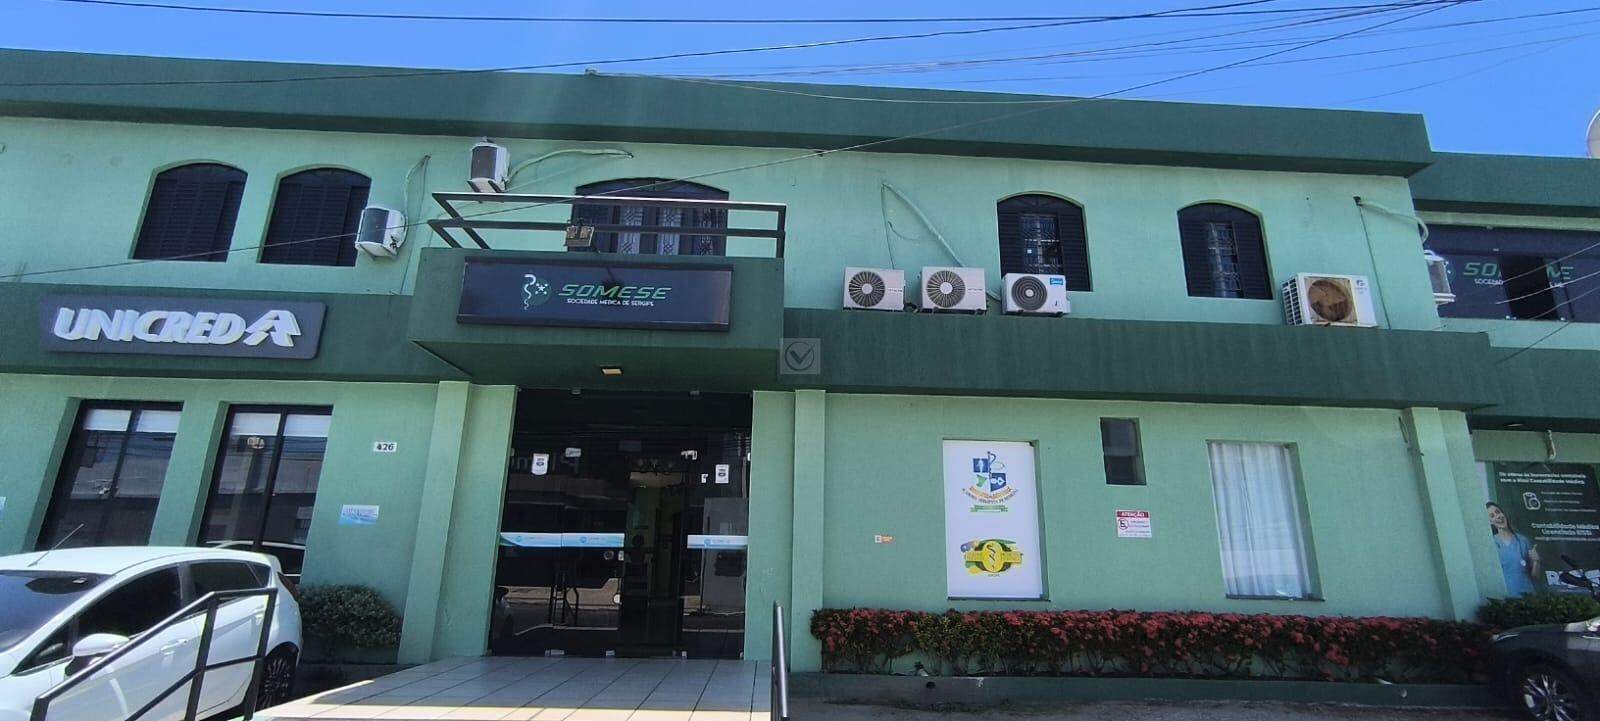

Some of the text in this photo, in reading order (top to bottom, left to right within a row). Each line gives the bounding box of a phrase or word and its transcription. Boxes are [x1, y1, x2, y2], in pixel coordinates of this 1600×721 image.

[558, 284, 673, 300] SOMESE
[52, 307, 248, 346] UNICRED
[376, 443, 395, 451] 426
